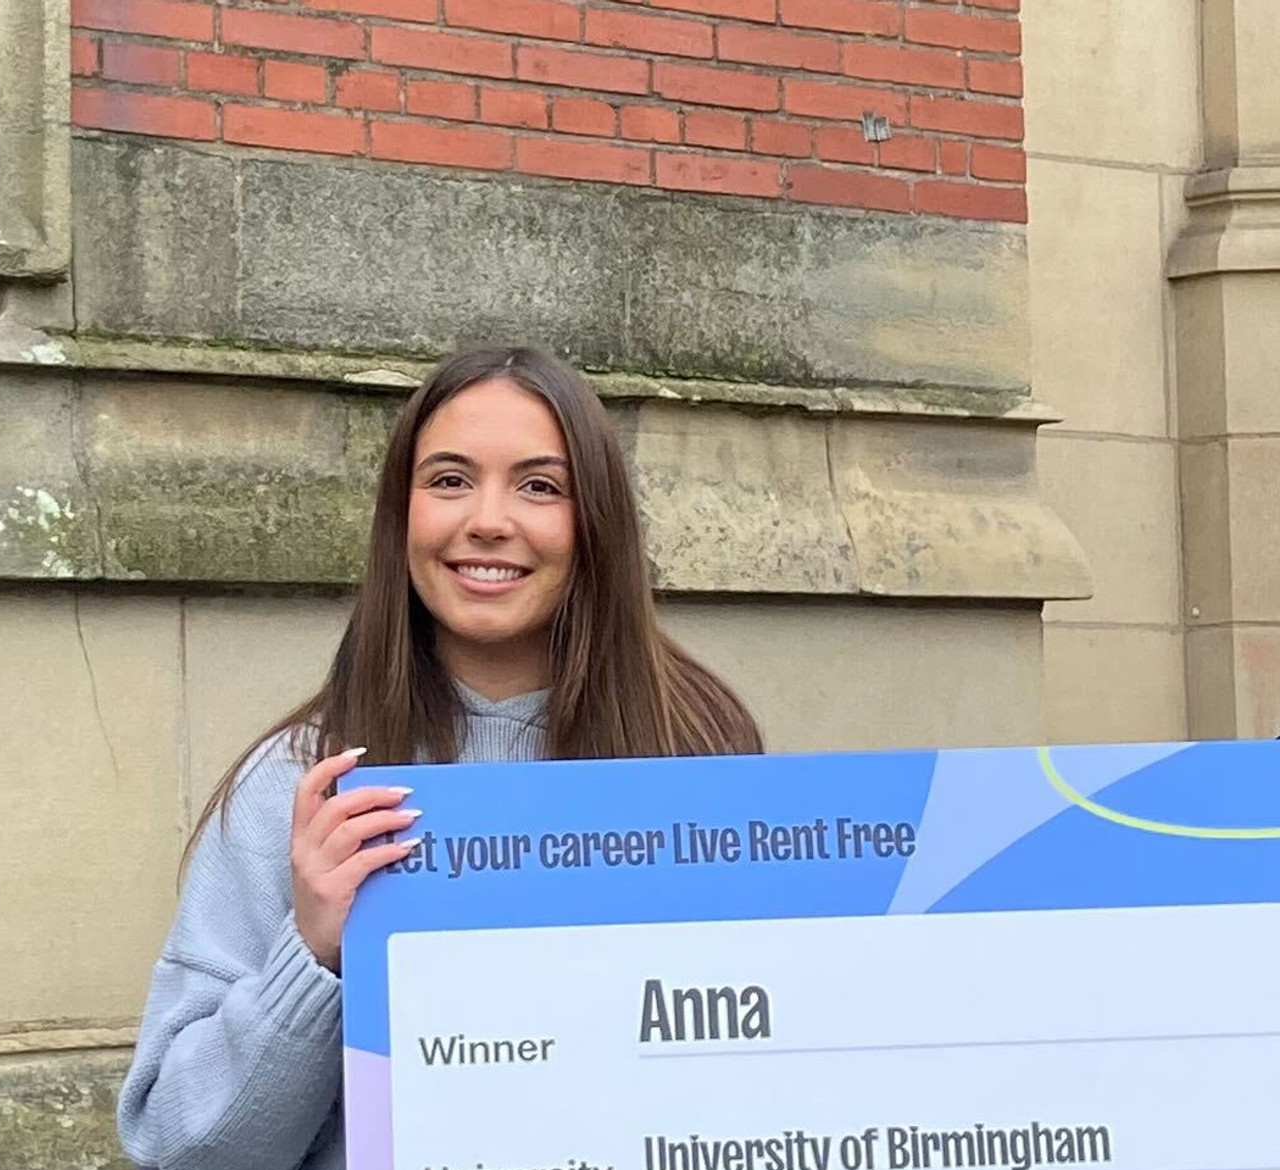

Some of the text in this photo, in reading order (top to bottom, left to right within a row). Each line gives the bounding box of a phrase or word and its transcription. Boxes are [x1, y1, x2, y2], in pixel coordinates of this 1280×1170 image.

[445, 834, 531, 878] your
[540, 829, 665, 869] career
[672, 822, 741, 864] Live
[748, 818, 830, 861] Rent
[836, 817, 915, 859] Free
[419, 979, 770, 1066] Winner Anna
[840, 1128, 878, 1170] of
